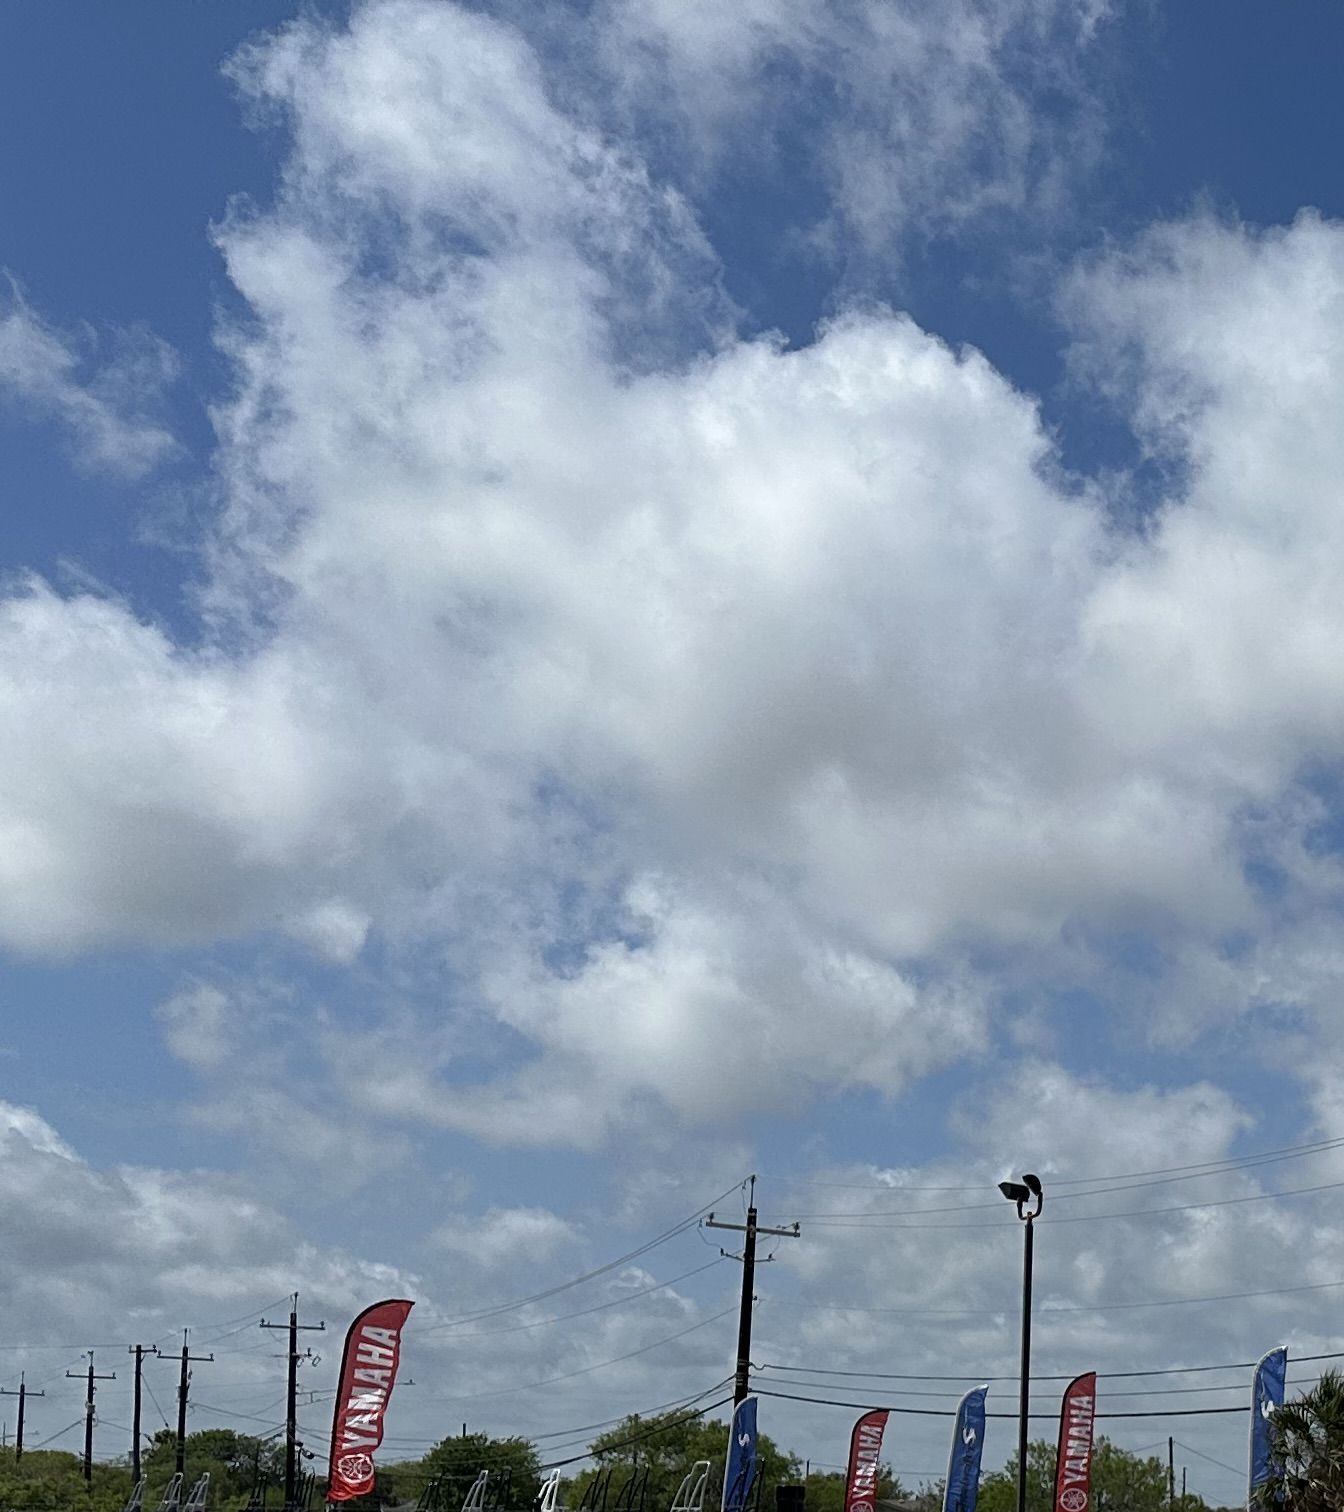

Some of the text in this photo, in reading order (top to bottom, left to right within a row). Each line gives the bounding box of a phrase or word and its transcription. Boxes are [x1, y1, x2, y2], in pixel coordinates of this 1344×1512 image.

[342, 1325, 398, 1450] YAMAHA
[852, 1424, 883, 1498] YAMAHA
[1063, 1395, 1093, 1485] YAMAHA
